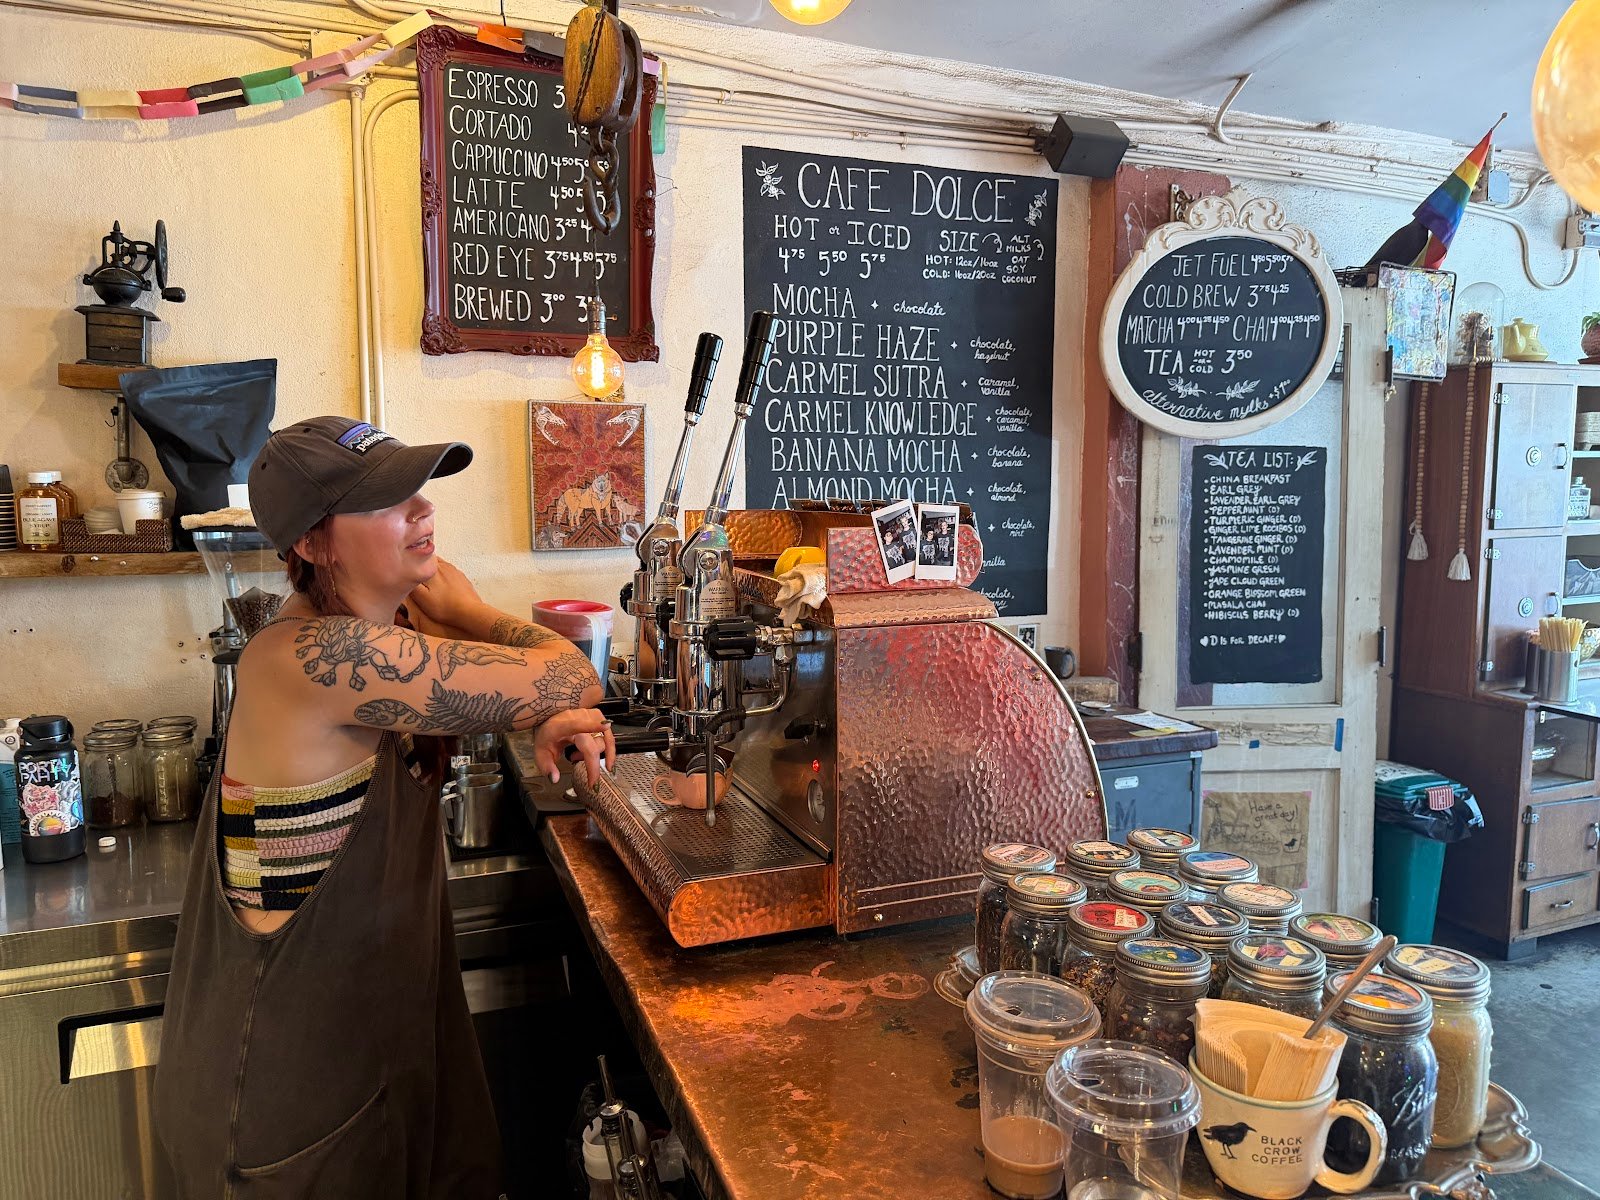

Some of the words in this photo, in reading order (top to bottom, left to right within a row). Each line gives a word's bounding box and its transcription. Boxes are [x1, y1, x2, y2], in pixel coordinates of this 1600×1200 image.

[449, 68, 538, 108] ESPRESSO
[450, 105, 532, 141] CORTADO
[452, 140, 548, 179] CAPPUCCINO
[452, 175, 525, 209] LATTE
[798, 162, 890, 213] CAFE
[911, 169, 1016, 224] DOLCE
[453, 208, 550, 242] AMERICANO
[774, 214, 820, 241] HOT
[847, 221, 911, 250] ICED
[939, 229, 980, 252] SIZE
[1010, 234, 1031, 244] ALT
[1006, 244, 1032, 253] MILKS
[453, 242, 489, 276] RED
[497, 245, 535, 281] EYE
[925, 254, 952, 266] HOT:
[1011, 255, 1030, 265] OAT
[1171, 253, 1206, 277] JET
[1210, 252, 1250, 277] FUEL
[922, 268, 951, 279] COLD:
[1005, 264, 1027, 274] SOY
[1001, 275, 1037, 284] COCONUT
[454, 283, 532, 322] BREWED
[773, 283, 857, 319] MOCHA
[1143, 284, 1188, 309] COLD
[1192, 284, 1241, 310] BREW
[893, 300, 947, 317] chocolate
[1125, 314, 1175, 345] MATCHA
[1232, 314, 1269, 342] CHAI
[773, 321, 865, 359] PURPLE
[876, 324, 940, 362] HAZE
[974, 349, 1010, 364] hazelnut
[1194, 349, 1215, 358] HOT
[1144, 349, 1183, 375] TEA
[1189, 364, 1214, 374] COLD
[765, 358, 867, 397] CARMEL
[873, 364, 949, 399] SUTRA
[980, 386, 1011, 396] vanilla
[1142, 389, 1224, 420] alternative
[1229, 397, 1269, 419] mylks
[764, 398, 859, 435] CARMEL
[864, 401, 978, 437] KNOWLEDGE
[996, 424, 1025, 432] vanilla
[771, 437, 879, 473] BANANA
[886, 439, 963, 474] MOCHA
[1227, 451, 1257, 468] TEA
[1263, 451, 1294, 468] LIST:
[991, 457, 1024, 468] banana
[1210, 475, 1240, 483] CHINA
[1242, 473, 1291, 485] BREAKFAST
[880, 477, 957, 503] MOCHA
[1210, 485, 1235, 495] EARL
[1236, 484, 1262, 497] GREY
[990, 493, 1016, 501] almond
[1210, 496, 1253, 505] LAVENDER
[1253, 496, 1277, 505] EARL
[1278, 495, 1301, 506] GREY
[1209, 505, 1265, 515] PEPPERMINT
[1268, 505, 1280, 514] (D)
[1209, 516, 1255, 526] TURMERIC
[1256, 515, 1287, 524] GINGER
[1289, 514, 1302, 524] (D)
[1208, 526, 1240, 536] GINGER
[1240, 525, 1260, 535] LIME
[1294, 524, 1306, 535] (D)
[1210, 535, 1254, 545] TANGERINE
[1254, 535, 1284, 545] GINGER
[1285, 535, 1298, 544] (D)
[1208, 545, 1255, 555] LAVENDER
[1256, 545, 1280, 554] MINT
[1281, 545, 1294, 555] (D)
[1209, 556, 1264, 564] CHAMOMILE
[1268, 556, 1279, 564] (D)
[1208, 565, 1250, 576] JASMINE
[1251, 565, 1280, 575] GREEN
[1208, 577, 1229, 589] JADE
[1230, 577, 1258, 585] CLOUD
[1259, 577, 1285, 587] GREEN
[1208, 589, 1243, 599] ORANGE
[1244, 588, 1278, 598] BLOSSOM
[1279, 588, 1306, 599] GREEN
[1208, 600, 1244, 609] MASALA
[1245, 600, 1266, 609] CHAI
[1208, 610, 1249, 620] HIBISCUS
[1252, 609, 1285, 621] BERRY
[1287, 608, 1300, 617] (D)
[1210, 635, 1218, 645] D
[1247, 634, 1278, 645] DECAF!
[1248, 800, 1273, 814] Have
[1253, 811, 1278, 829] great
[1279, 804, 1299, 822] day!
[1260, 1135, 1303, 1146] BLACK
[1263, 1146, 1301, 1156] CROW
[1251, 1154, 1303, 1165] COFFEE
